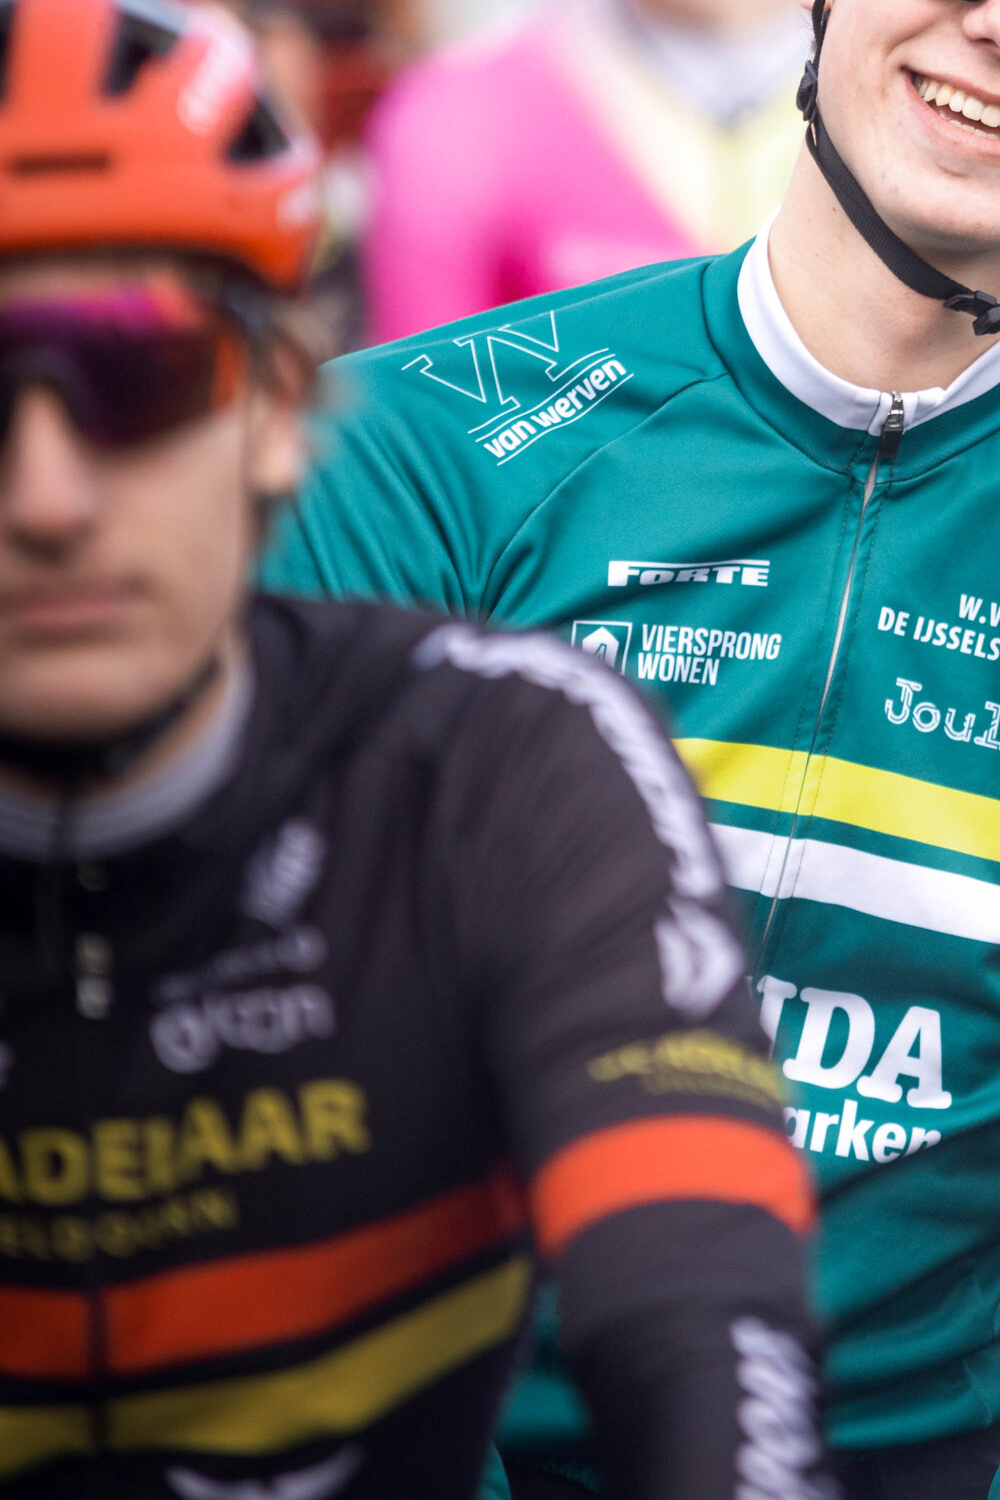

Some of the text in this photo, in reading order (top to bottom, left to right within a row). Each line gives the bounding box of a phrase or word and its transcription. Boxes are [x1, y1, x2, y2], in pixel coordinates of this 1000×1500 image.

[483, 420, 537, 458] van
[530, 359, 627, 428] werven
[607, 559, 770, 587] FORTE
[877, 606, 910, 636] DE
[642, 623, 782, 661] VIERSPRONG
[637, 652, 720, 686] WONEN
